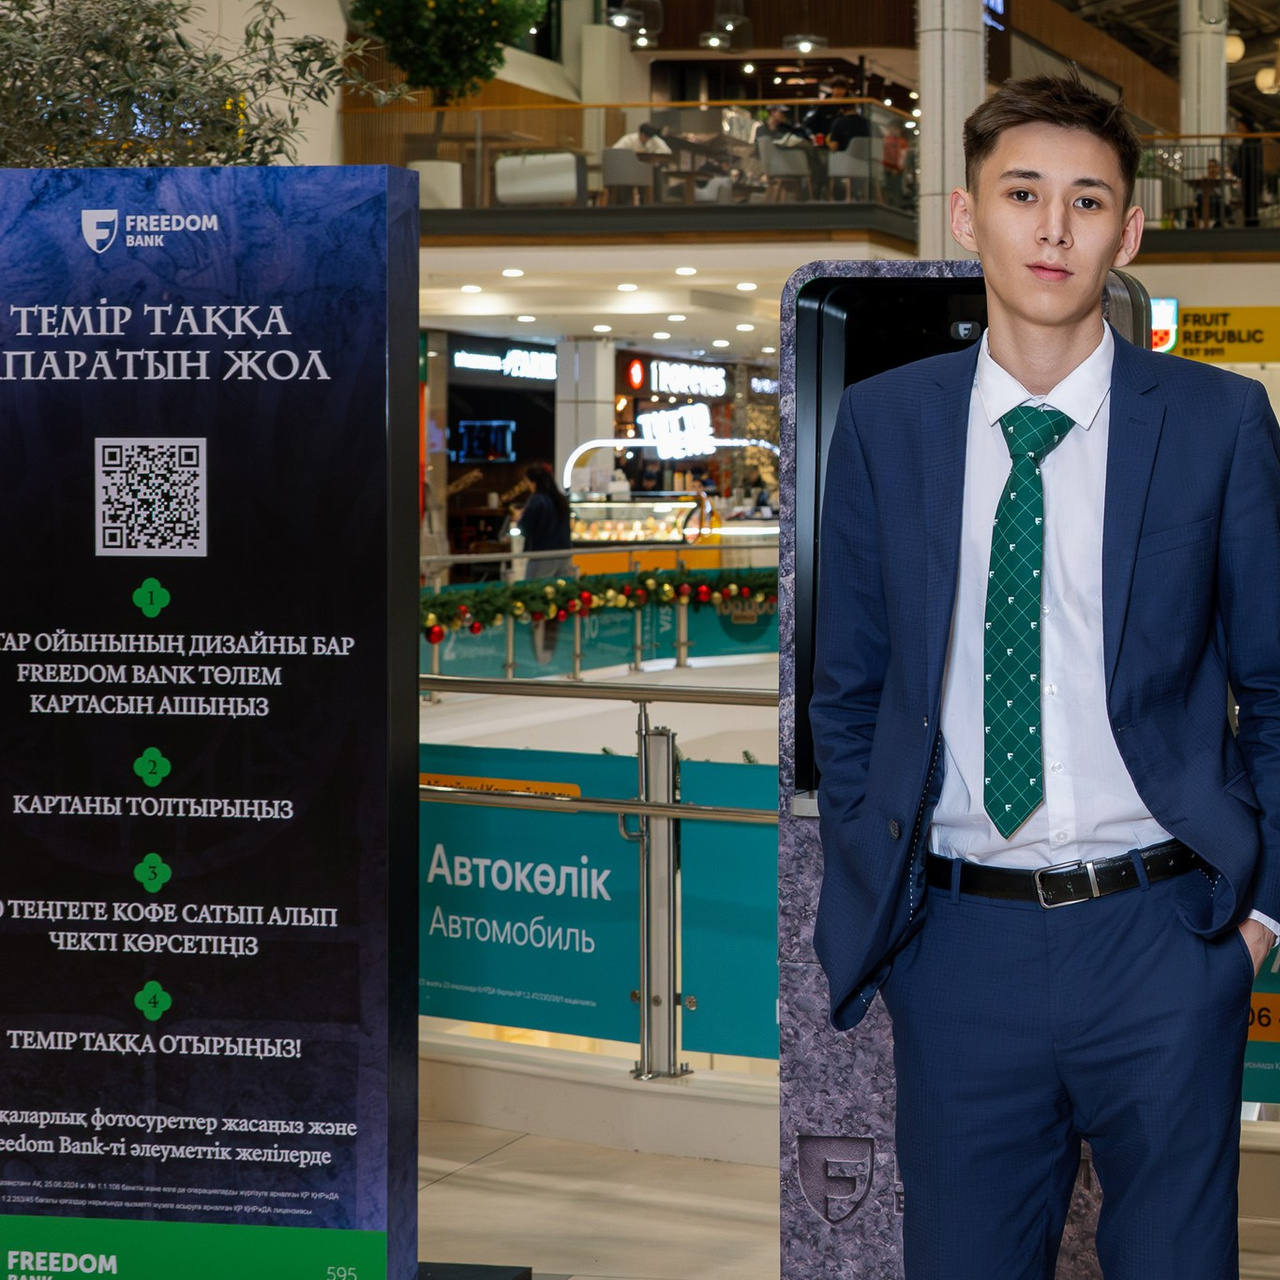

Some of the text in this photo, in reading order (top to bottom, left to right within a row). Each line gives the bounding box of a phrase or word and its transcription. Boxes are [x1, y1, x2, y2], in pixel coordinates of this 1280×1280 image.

[126, 214, 218, 232] FREEDOM
[126, 235, 164, 247] BANK
[143, 303, 292, 339] ТАҚҚА
[1182, 312, 1230, 327] FRUIT
[1182, 328, 1264, 344] REPUBLIC
[0, 349, 331, 381] ПАРАТЫН ЖОЛ
[148, 591, 156, 605] 1
[34, 629, 186, 656] ОЙЫНЫНЫҢ
[189, 631, 307, 656] ДИЗАЙНЫ
[312, 636, 355, 656] БАР
[17, 664, 282, 686] FREEDOM BANK ТӨЛЕМ
[30, 694, 269, 719] КАРТАСЫН АШЫҢЫЗ
[148, 760, 157, 775] 2
[13, 795, 294, 821] КАРТАНЫ ТОЛТЫРЫҢЫЗ
[148, 865, 158, 881] 3
[427, 843, 612, 901] Автокөлік
[8, 900, 108, 922] ТЕҢГЕГЕ
[112, 902, 178, 922] КОФЕ
[182, 904, 264, 925] САТЫП
[267, 907, 338, 927] АЛЫП
[429, 905, 596, 953] Автомобиль
[49, 931, 259, 958] ЧЕКТІ КӨРСЕТІҢІЗ
[148, 994, 159, 1008] 4
[7, 1030, 302, 1060] ТЕМІР ТАҚҚА ОТЫРЫҢЫЗ!
[91, 1107, 217, 1134] фотосуреттер
[222, 1117, 304, 1137] жасаңыз
[308, 1121, 358, 1138] және
[59, 1137, 126, 1157] Bank-ті
[130, 1141, 232, 1164] әлеуметтік
[236, 1145, 332, 1167] желілерде
[7, 1250, 118, 1274] FREEDOM
